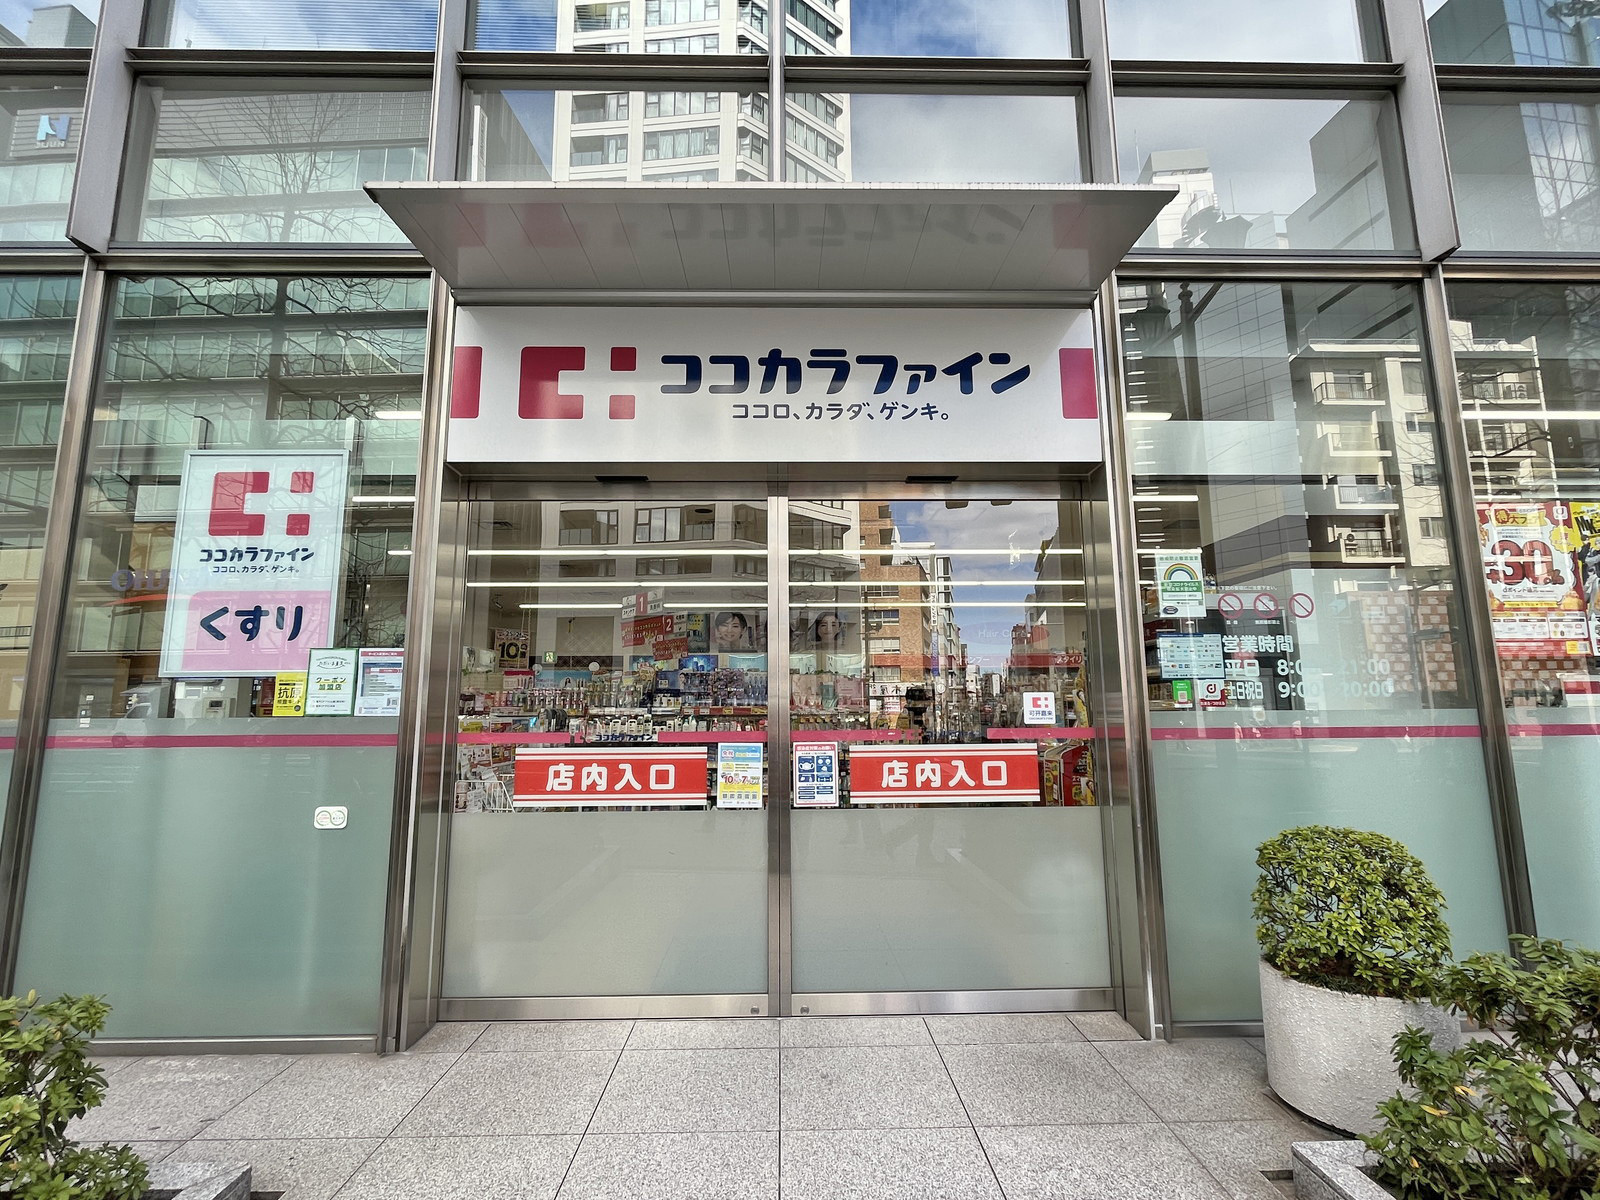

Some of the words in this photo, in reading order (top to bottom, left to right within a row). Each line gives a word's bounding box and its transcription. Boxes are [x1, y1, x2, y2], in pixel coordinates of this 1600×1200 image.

[661, 348, 1031, 395] ココカラファイン
[732, 402, 950, 422] ココロ、カラダ、ゲンキ。
[199, 547, 314, 562] ココカラファイン
[200, 605, 304, 642] くすり
[1222, 635, 1294, 653] 営業時間
[1224, 659, 1260, 677] 平日
[315, 676, 347, 684] クーポン
[546, 763, 675, 792] 店内入口
[881, 760, 1008, 788] 店内入口
